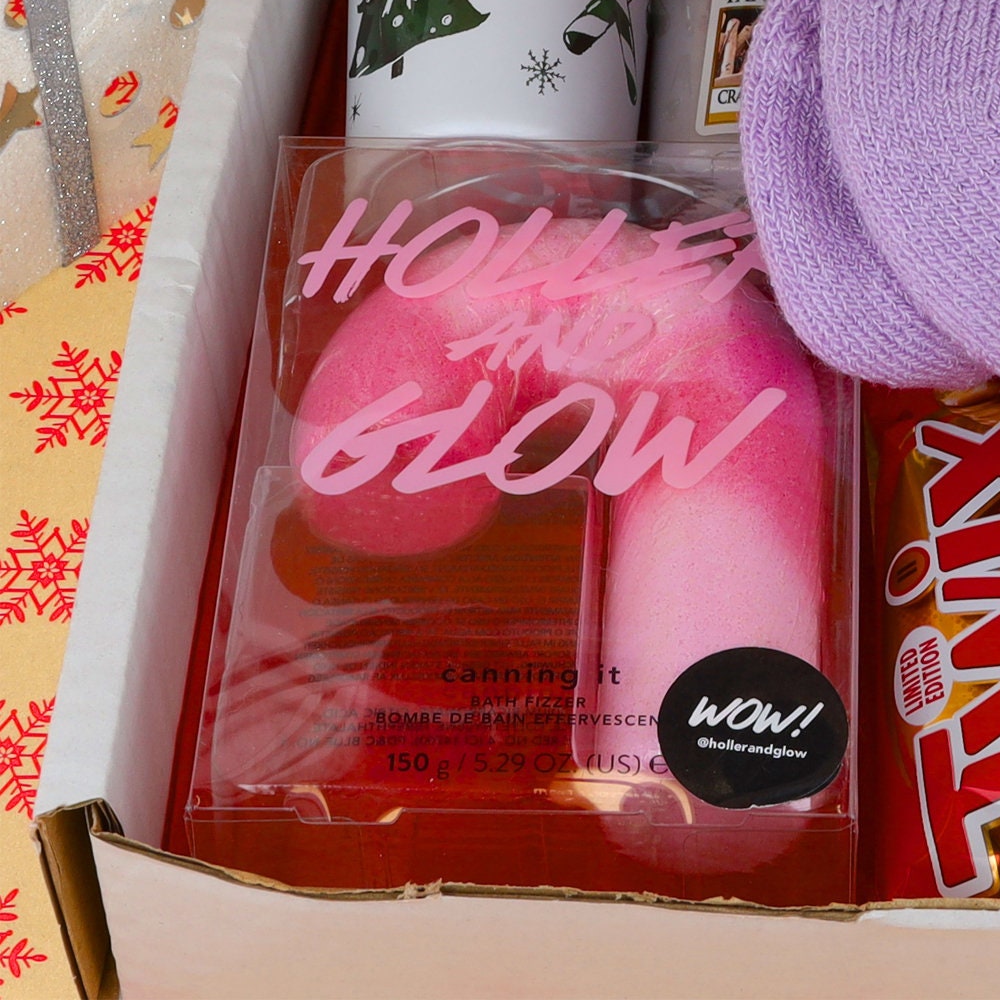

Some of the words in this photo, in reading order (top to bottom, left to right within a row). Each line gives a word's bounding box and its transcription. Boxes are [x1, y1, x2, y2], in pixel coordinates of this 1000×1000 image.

[444, 309, 657, 373] AND
[300, 380, 787, 496] GLOW
[441, 663, 579, 690] canning
[597, 664, 621, 685] it
[900, 648, 924, 716] LIMITED
[919, 637, 945, 704] EDITION
[375, 712, 442, 724] BOMBE
[450, 712, 474, 724] DE
[481, 713, 525, 725] BAIN
[534, 713, 659, 727] EFFERVESCEN
[470, 696, 517, 708] BATH
[525, 696, 586, 709] FIZZER
[687, 695, 825, 738] WOW!
[697, 736, 808, 759] @hollerandglow
[387, 752, 430, 772] 150
[436, 758, 450, 781] g
[473, 753, 526, 774] 5.29
[585, 753, 641, 777] (US)
